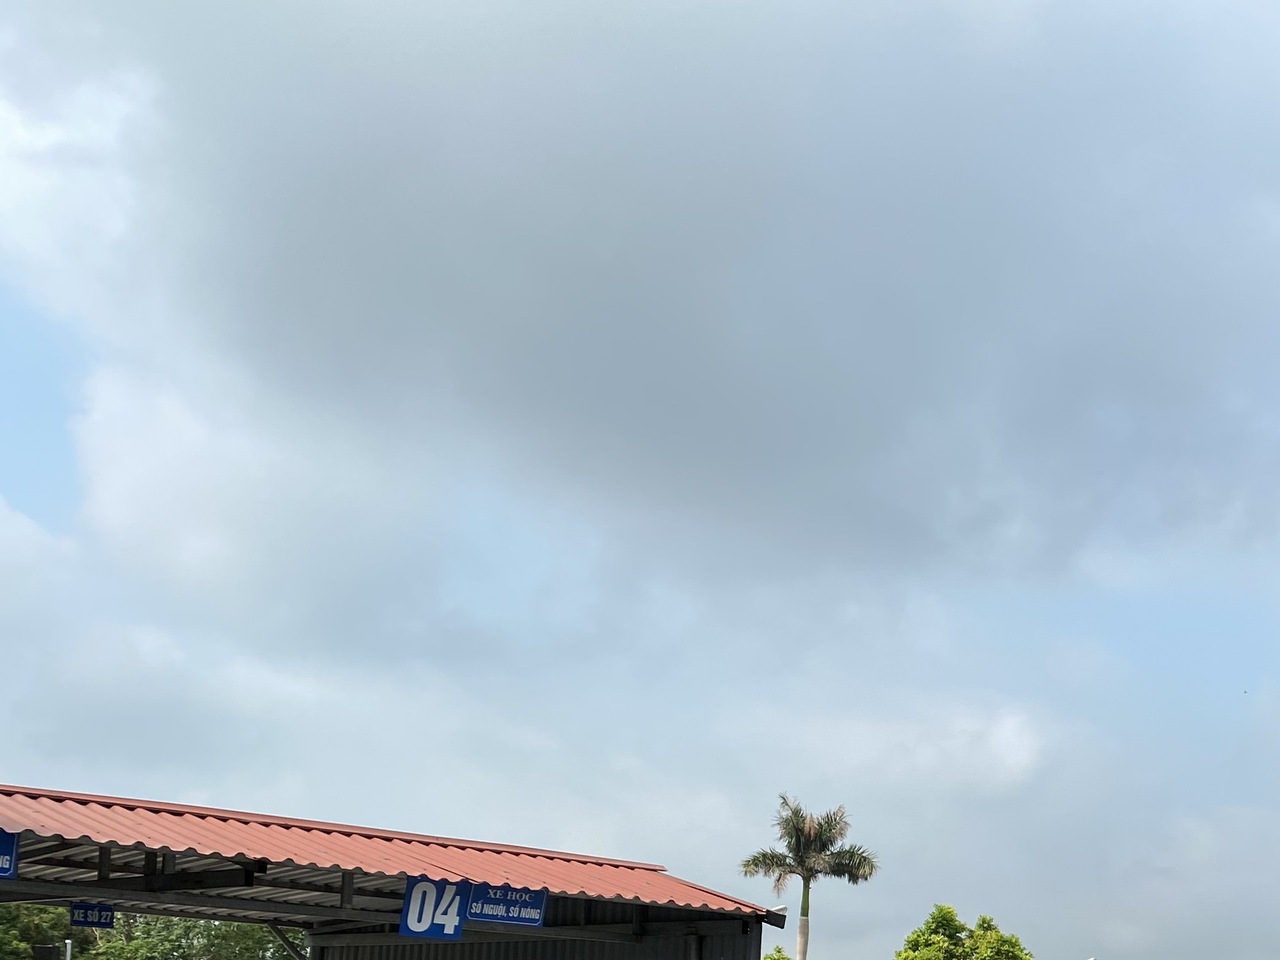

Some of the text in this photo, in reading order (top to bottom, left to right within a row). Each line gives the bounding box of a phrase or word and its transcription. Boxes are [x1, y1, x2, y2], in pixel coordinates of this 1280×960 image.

[487, 889, 535, 903] XE HỌC
[407, 881, 461, 935] 04
[520, 906, 541, 919] NÓNG
[73, 910, 85, 921] XE
[101, 911, 112, 923] 27
